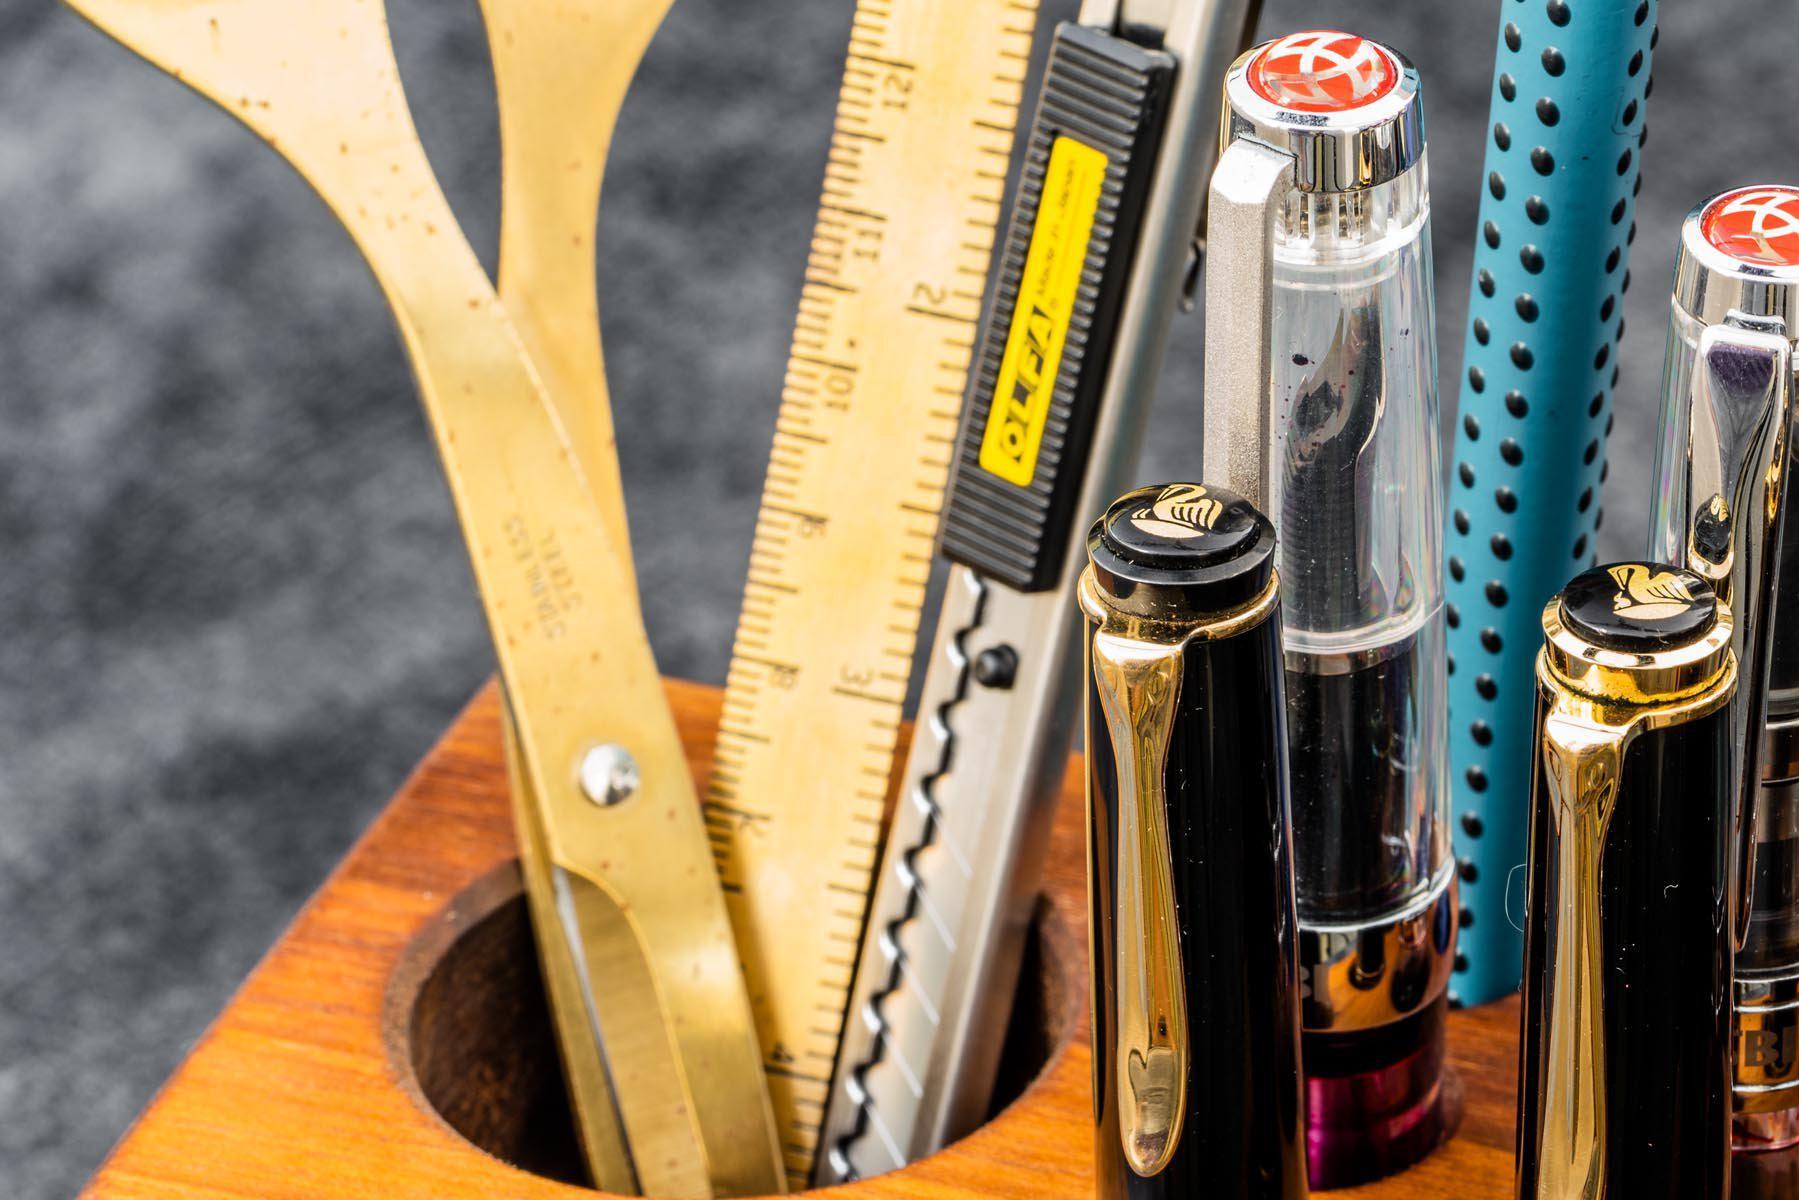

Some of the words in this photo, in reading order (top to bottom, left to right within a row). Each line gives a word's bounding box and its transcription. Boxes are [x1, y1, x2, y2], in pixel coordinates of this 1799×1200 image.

[880, 73, 914, 112] 12
[852, 229, 884, 263] 11
[823, 373, 856, 412] 10
[1000, 302, 1054, 465] OLFA
